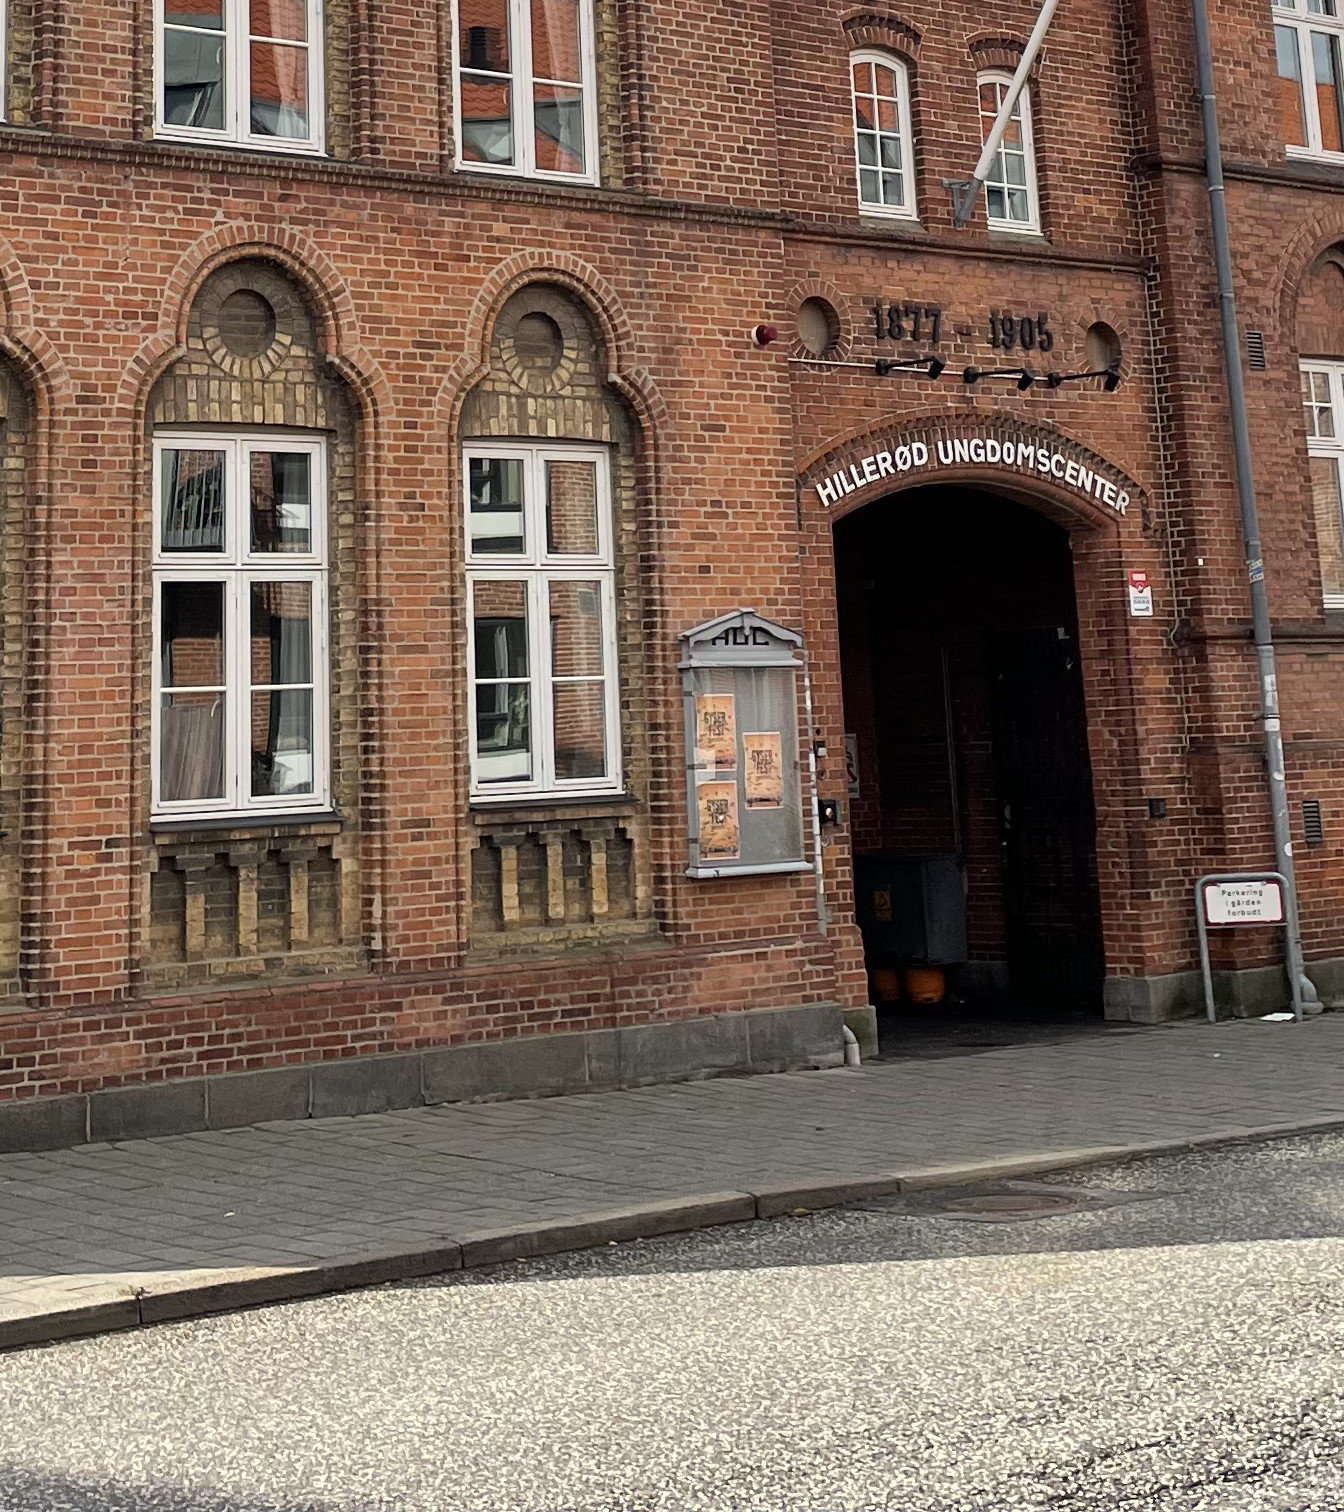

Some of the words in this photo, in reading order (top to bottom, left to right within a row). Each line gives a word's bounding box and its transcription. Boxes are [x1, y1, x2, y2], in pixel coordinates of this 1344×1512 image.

[873, 303, 941, 343] 1877
[987, 307, 1053, 352] 1905
[816, 441, 929, 507] HILLERØD
[938, 439, 1130, 515] UNGDOMSCENTER
[1222, 889, 1263, 897] Parkering
